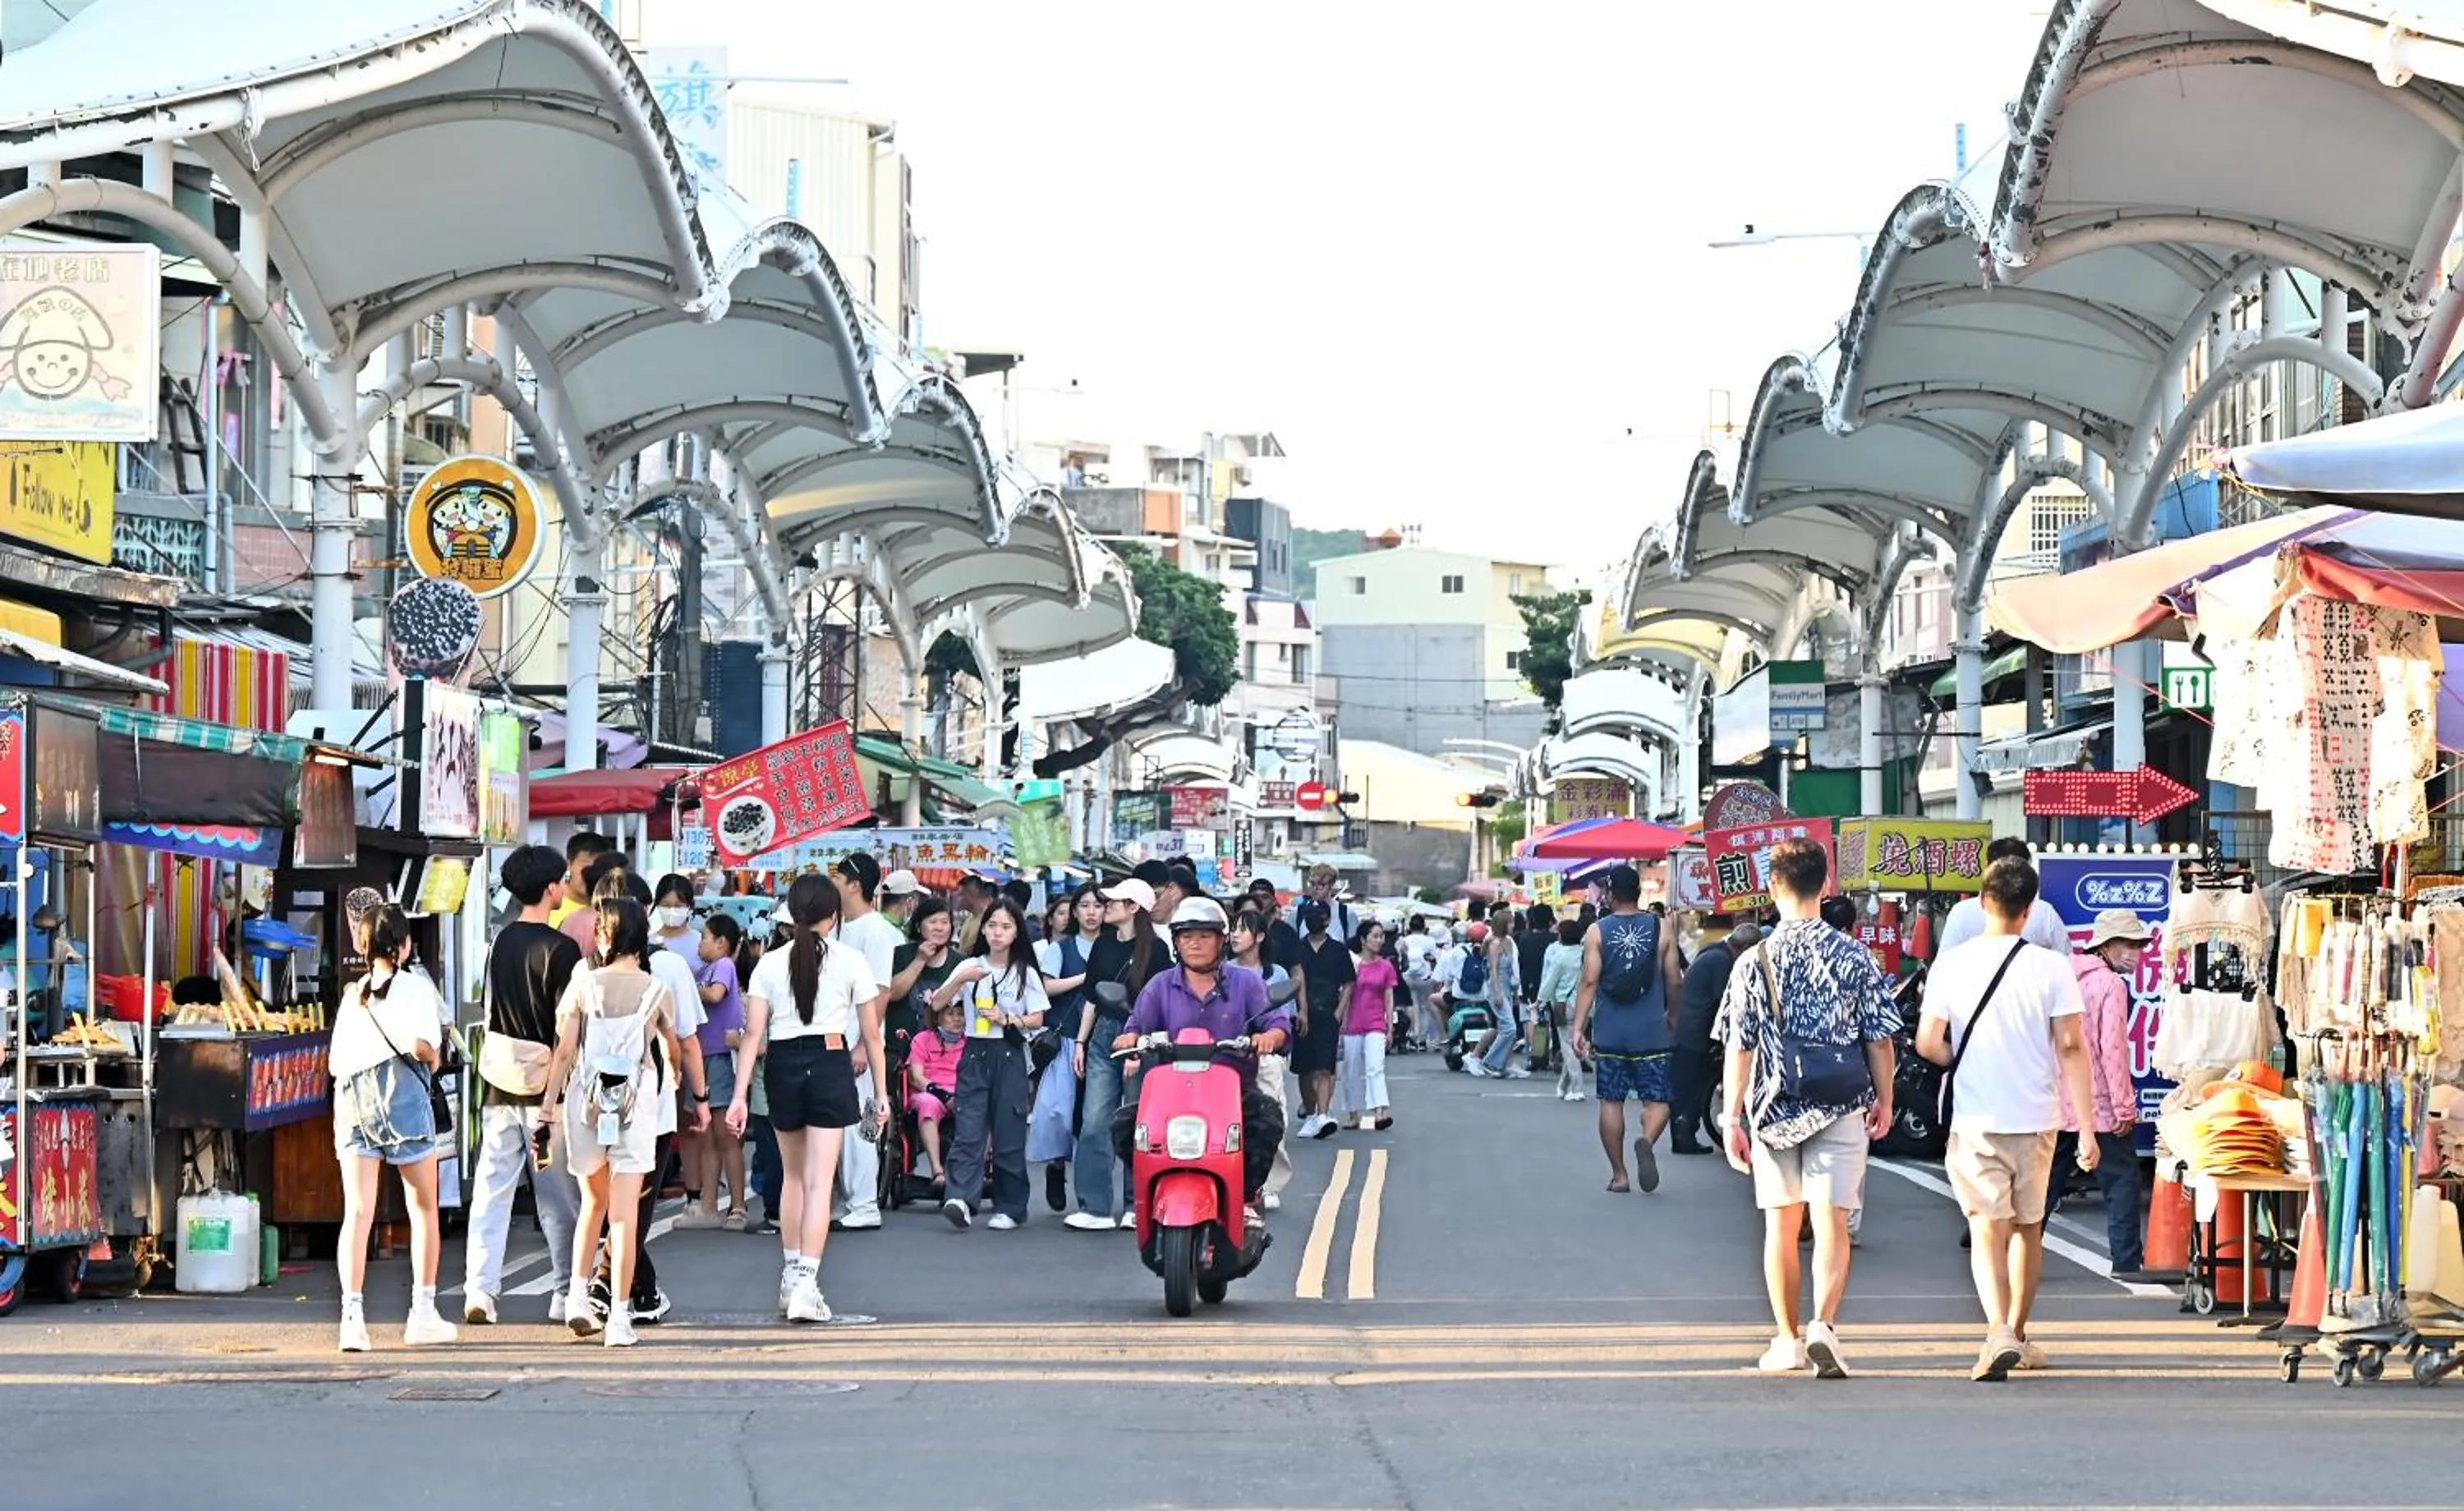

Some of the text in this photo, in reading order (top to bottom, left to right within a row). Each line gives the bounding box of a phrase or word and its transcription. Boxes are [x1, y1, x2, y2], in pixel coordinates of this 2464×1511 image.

[1772, 691, 1823, 702] FamilyMart
[1560, 782, 1627, 800] 金彩滿
[889, 842, 990, 864] 魚黑輪
[1876, 833, 1982, 879] 燒酒螺
[1860, 926, 1896, 944] 早味
